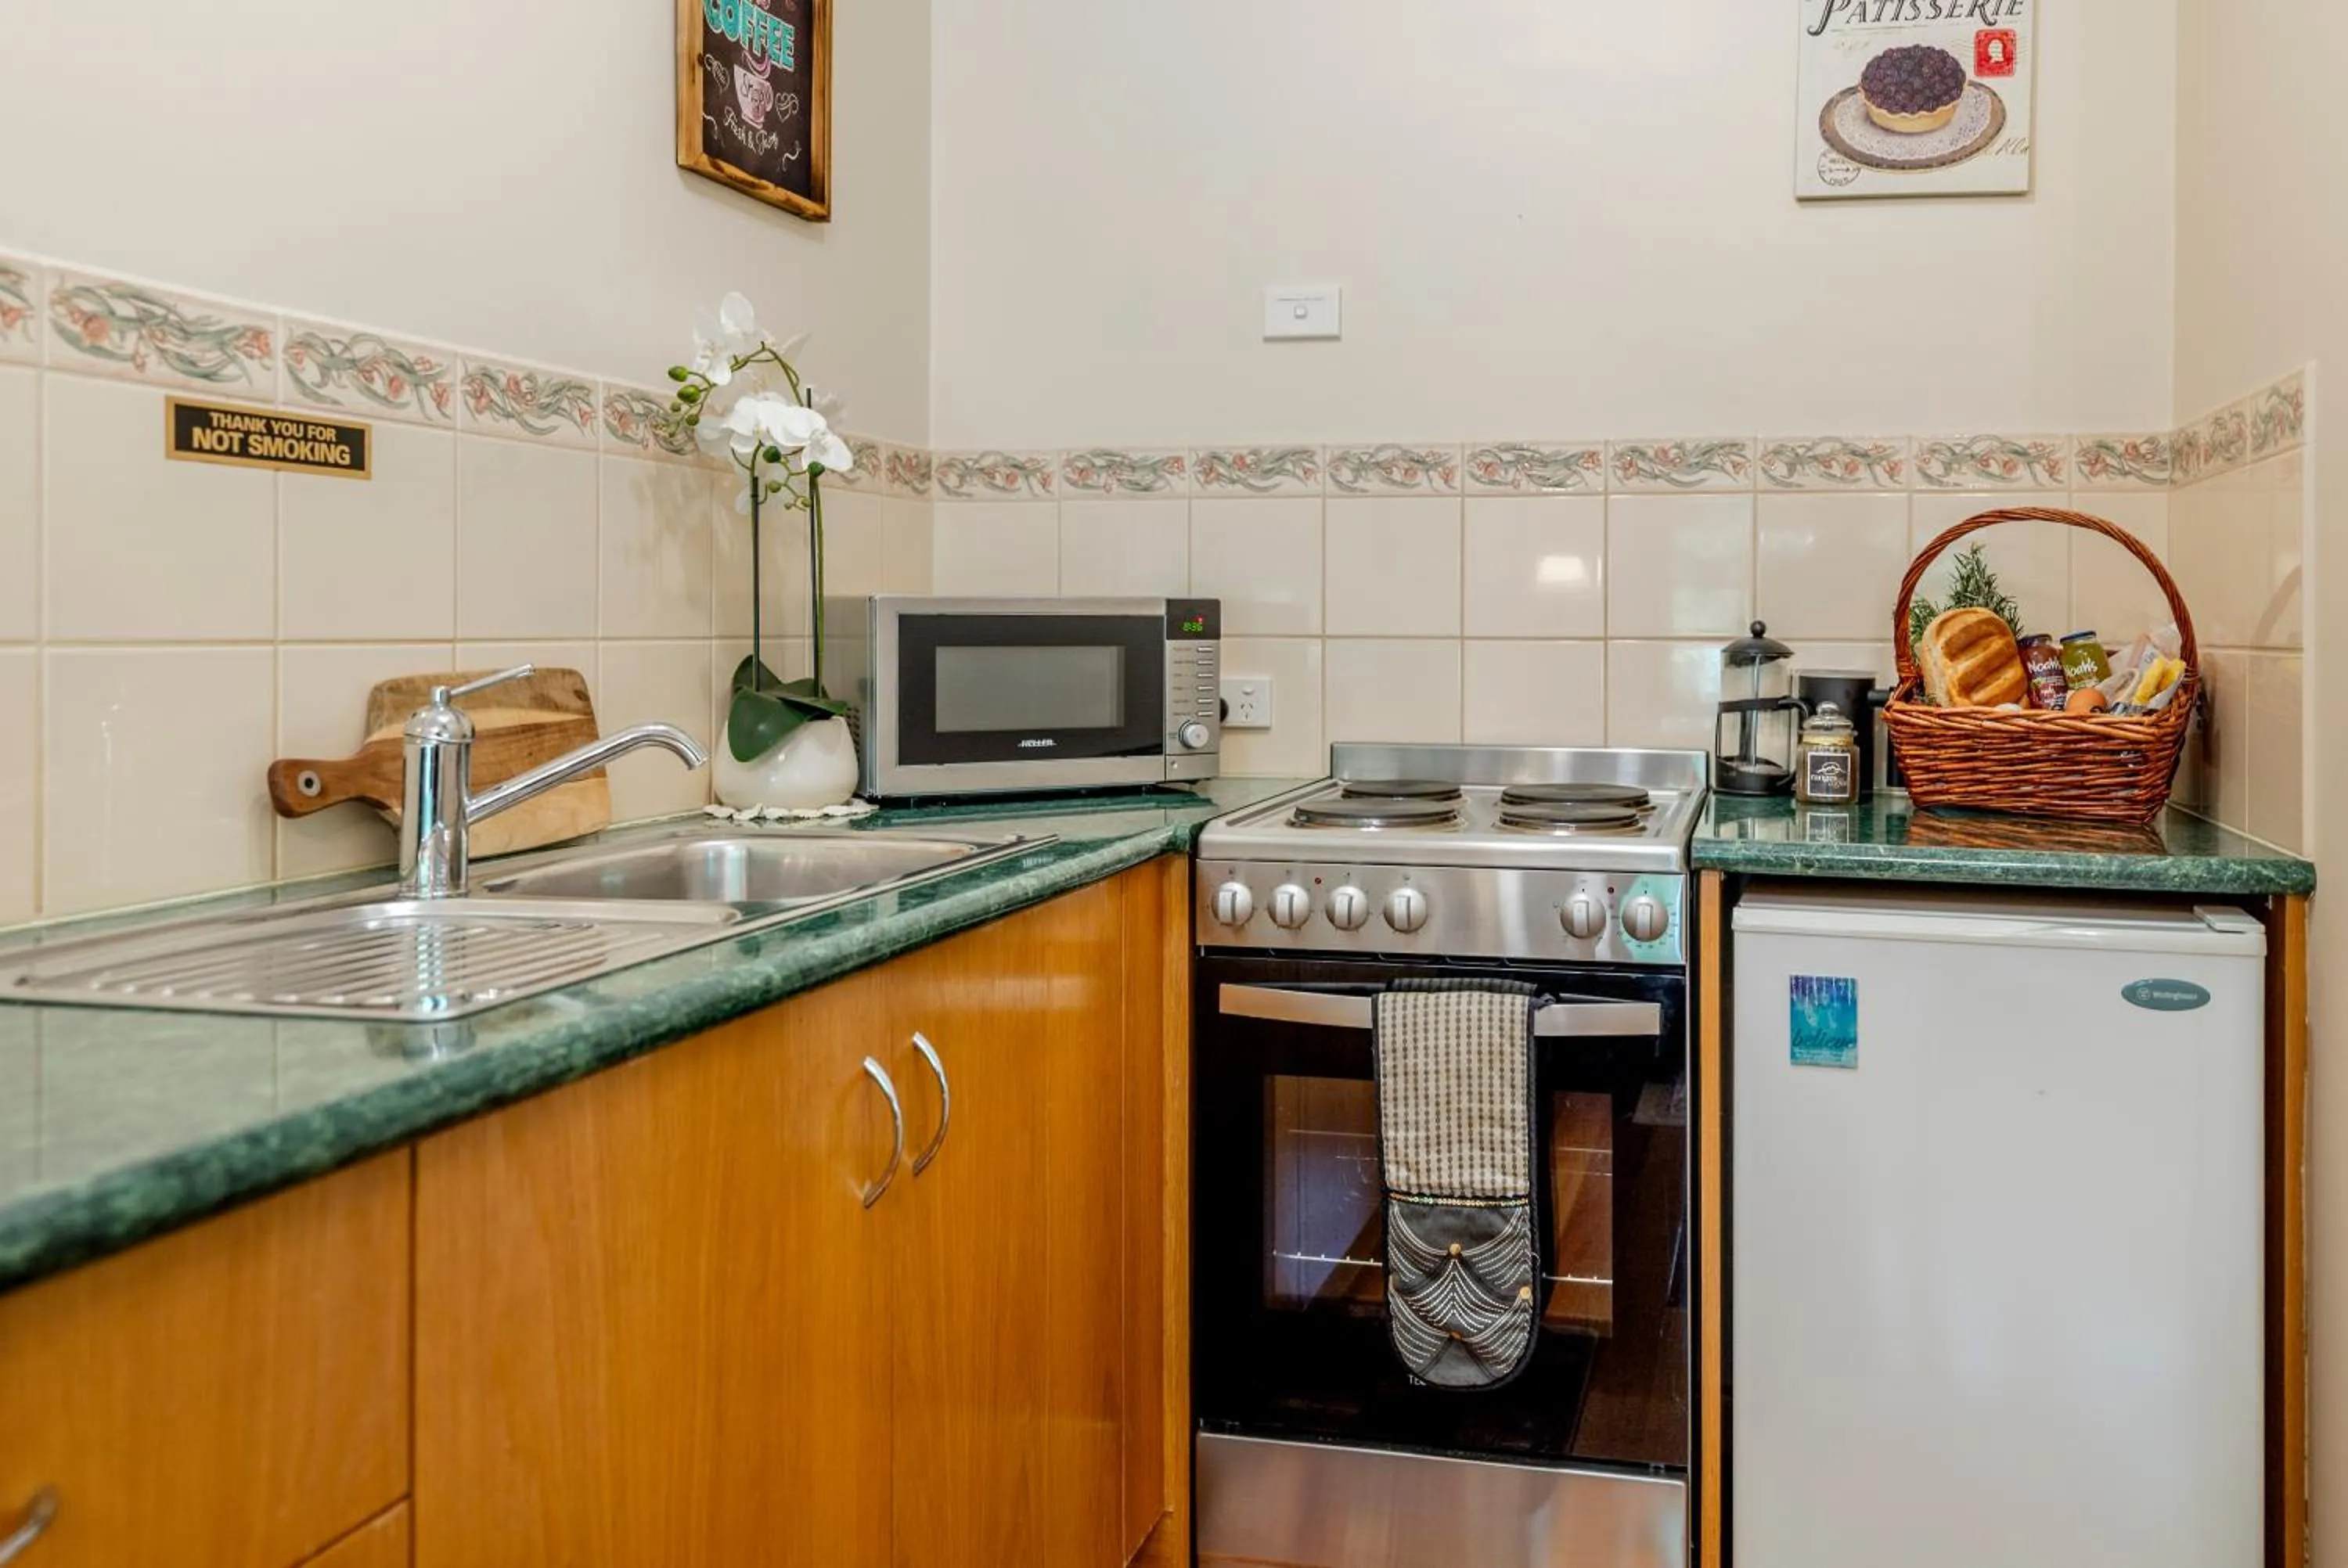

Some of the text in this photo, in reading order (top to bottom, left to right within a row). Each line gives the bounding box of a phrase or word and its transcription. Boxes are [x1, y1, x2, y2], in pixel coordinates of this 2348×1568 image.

[704, 0, 796, 72] COFFEE
[1806, 0, 2024, 36] PATISSERIE
[192, 426, 351, 466] NOT SMOKING
[209, 412, 337, 443] THANK YOU FOR
